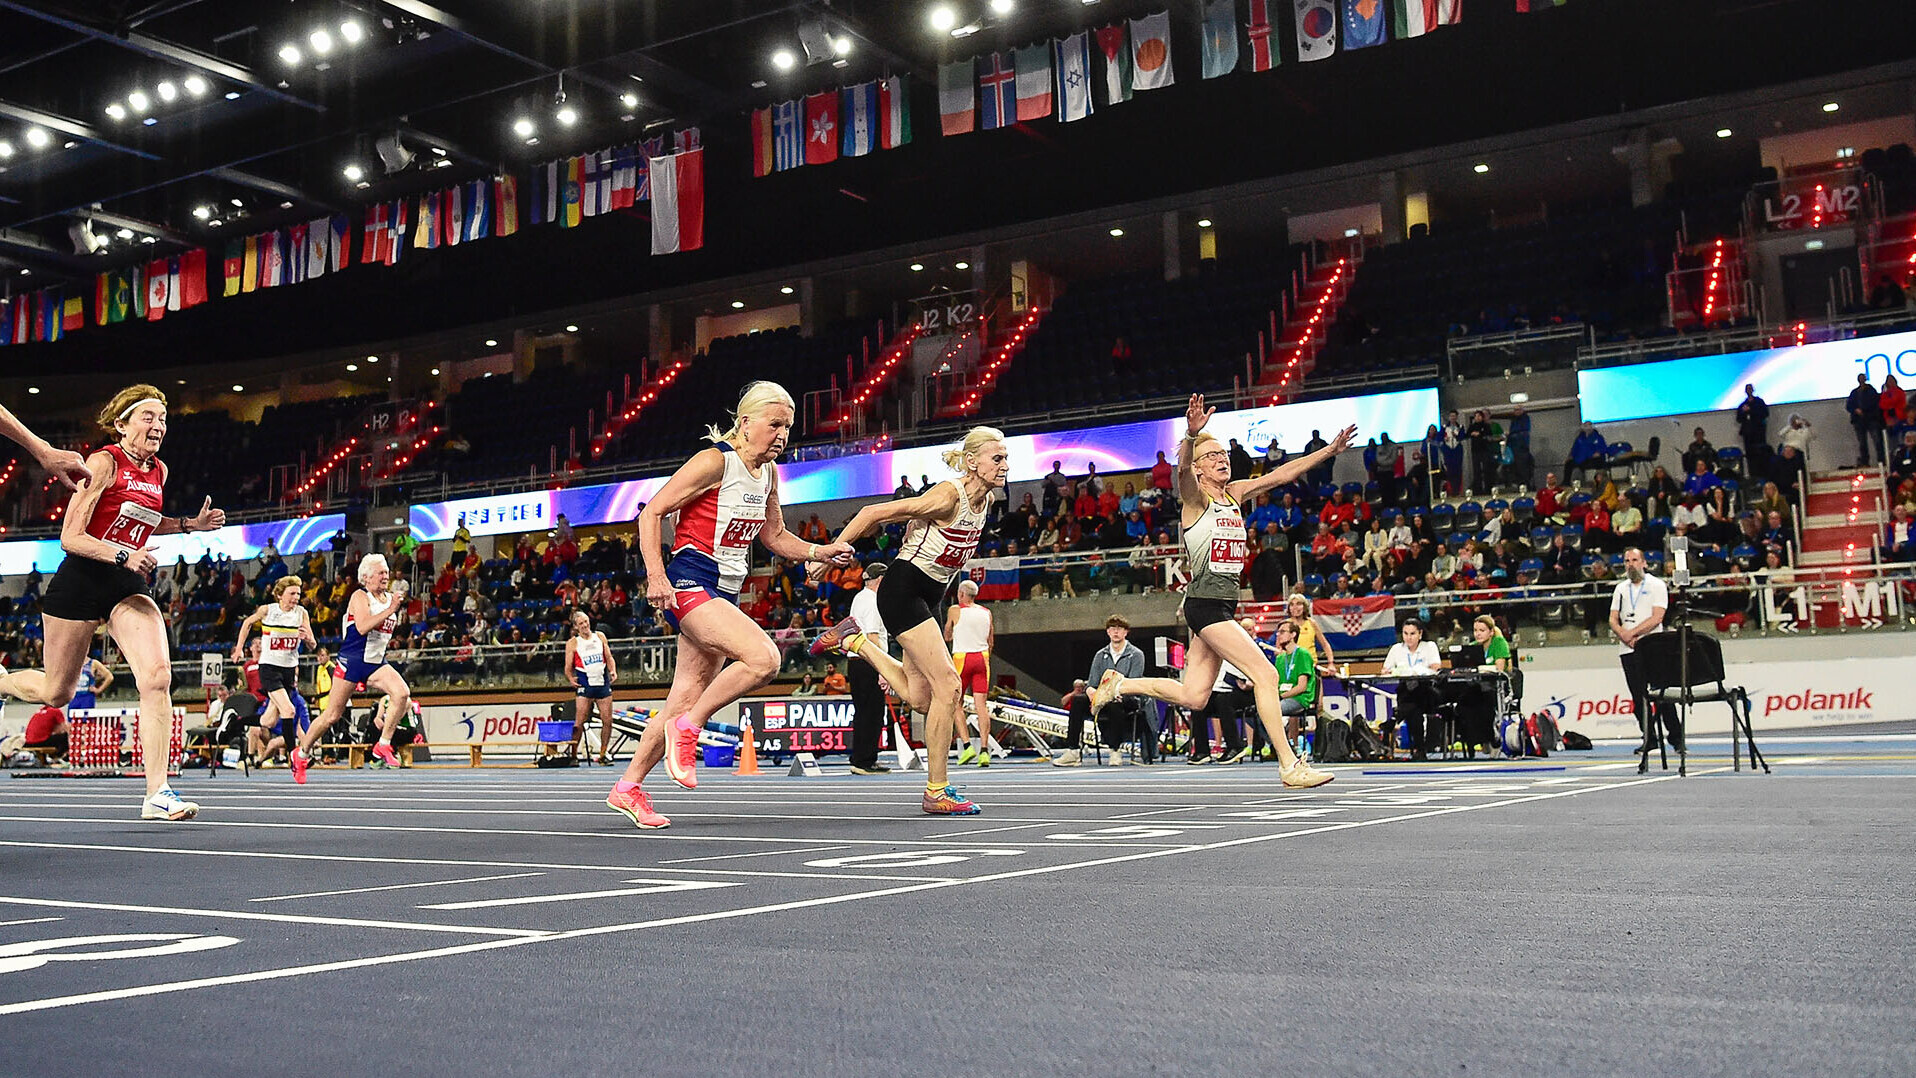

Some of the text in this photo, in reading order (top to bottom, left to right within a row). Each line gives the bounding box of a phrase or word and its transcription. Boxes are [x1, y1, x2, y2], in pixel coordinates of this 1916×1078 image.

[1764, 185, 1860, 222] L2 M2
[919, 303, 974, 330] J2 K2
[126, 479, 163, 495] AUSTRIA
[115, 516, 129, 529] 75
[129, 523, 146, 544] 41
[728, 520, 745, 533] 75
[946, 545, 962, 558] 75
[1213, 540, 1228, 551] 75
[1764, 580, 1899, 622] L1 M1
[206, 662, 222, 677] 60
[644, 647, 665, 673] J1
[1764, 687, 1874, 717] polanik
[764, 717, 787, 730] ESP
[788, 731, 847, 751] 11.31
